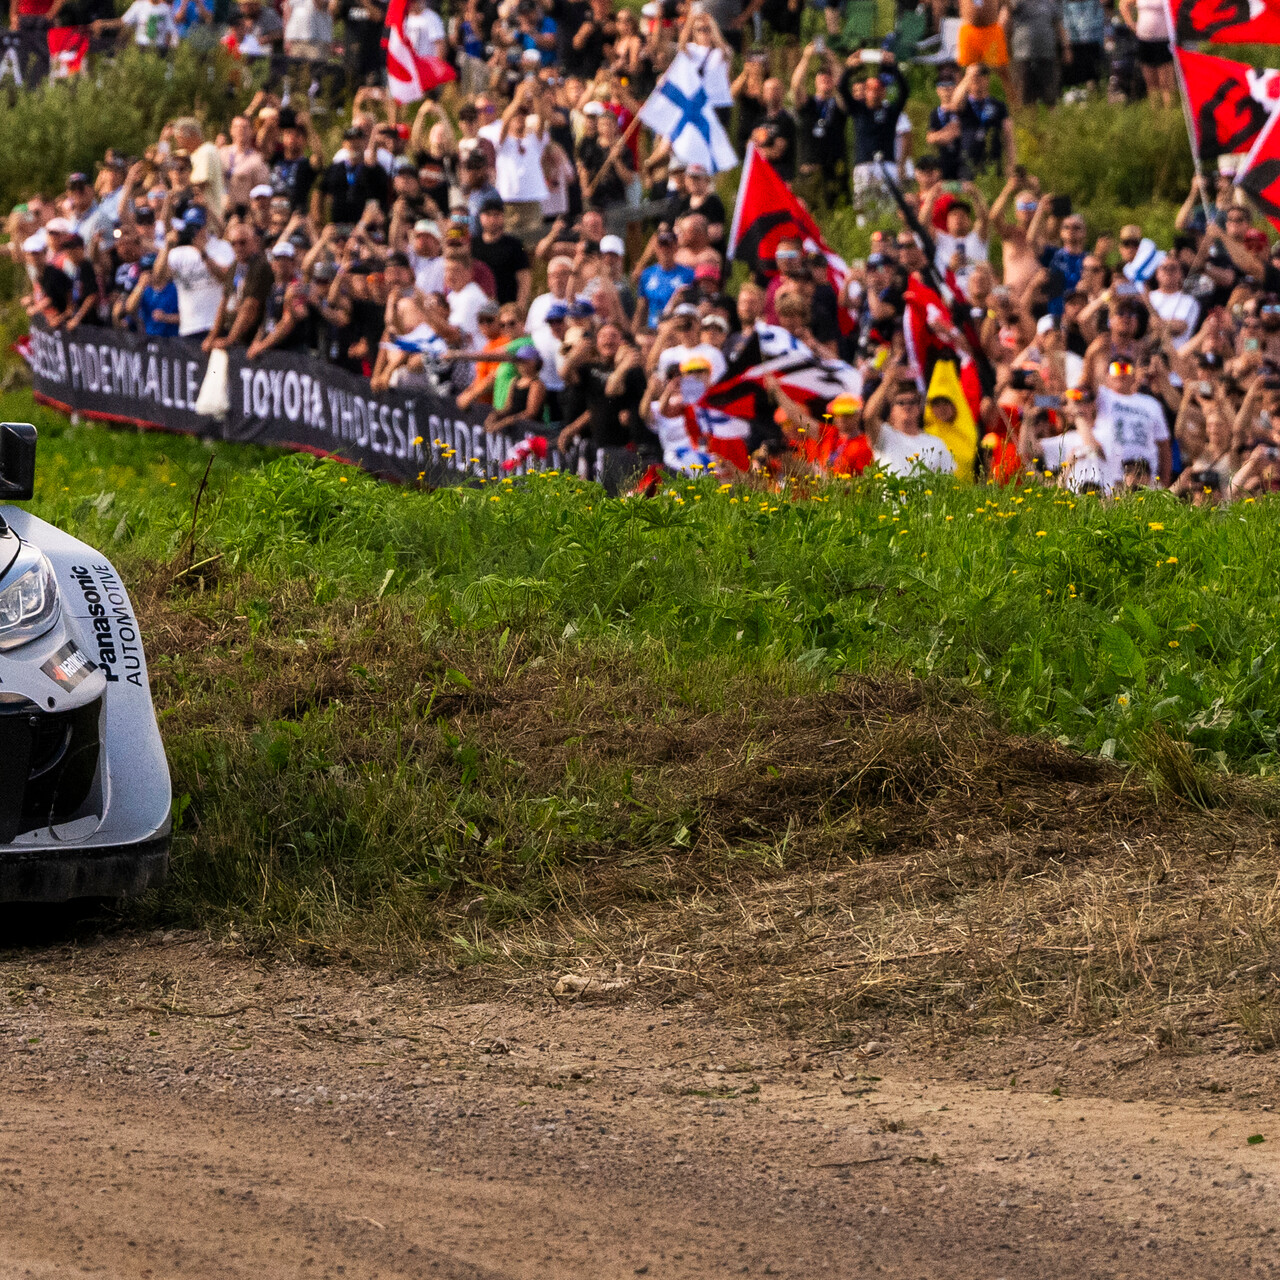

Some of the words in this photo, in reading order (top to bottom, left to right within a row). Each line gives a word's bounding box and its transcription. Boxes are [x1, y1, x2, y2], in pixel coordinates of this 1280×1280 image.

[239, 367, 326, 430] TOYOTA
[326, 388, 420, 461] YHDESSÄ
[70, 565, 120, 683] Panasonic
[92, 564, 143, 688] AUTOMOTIVE
